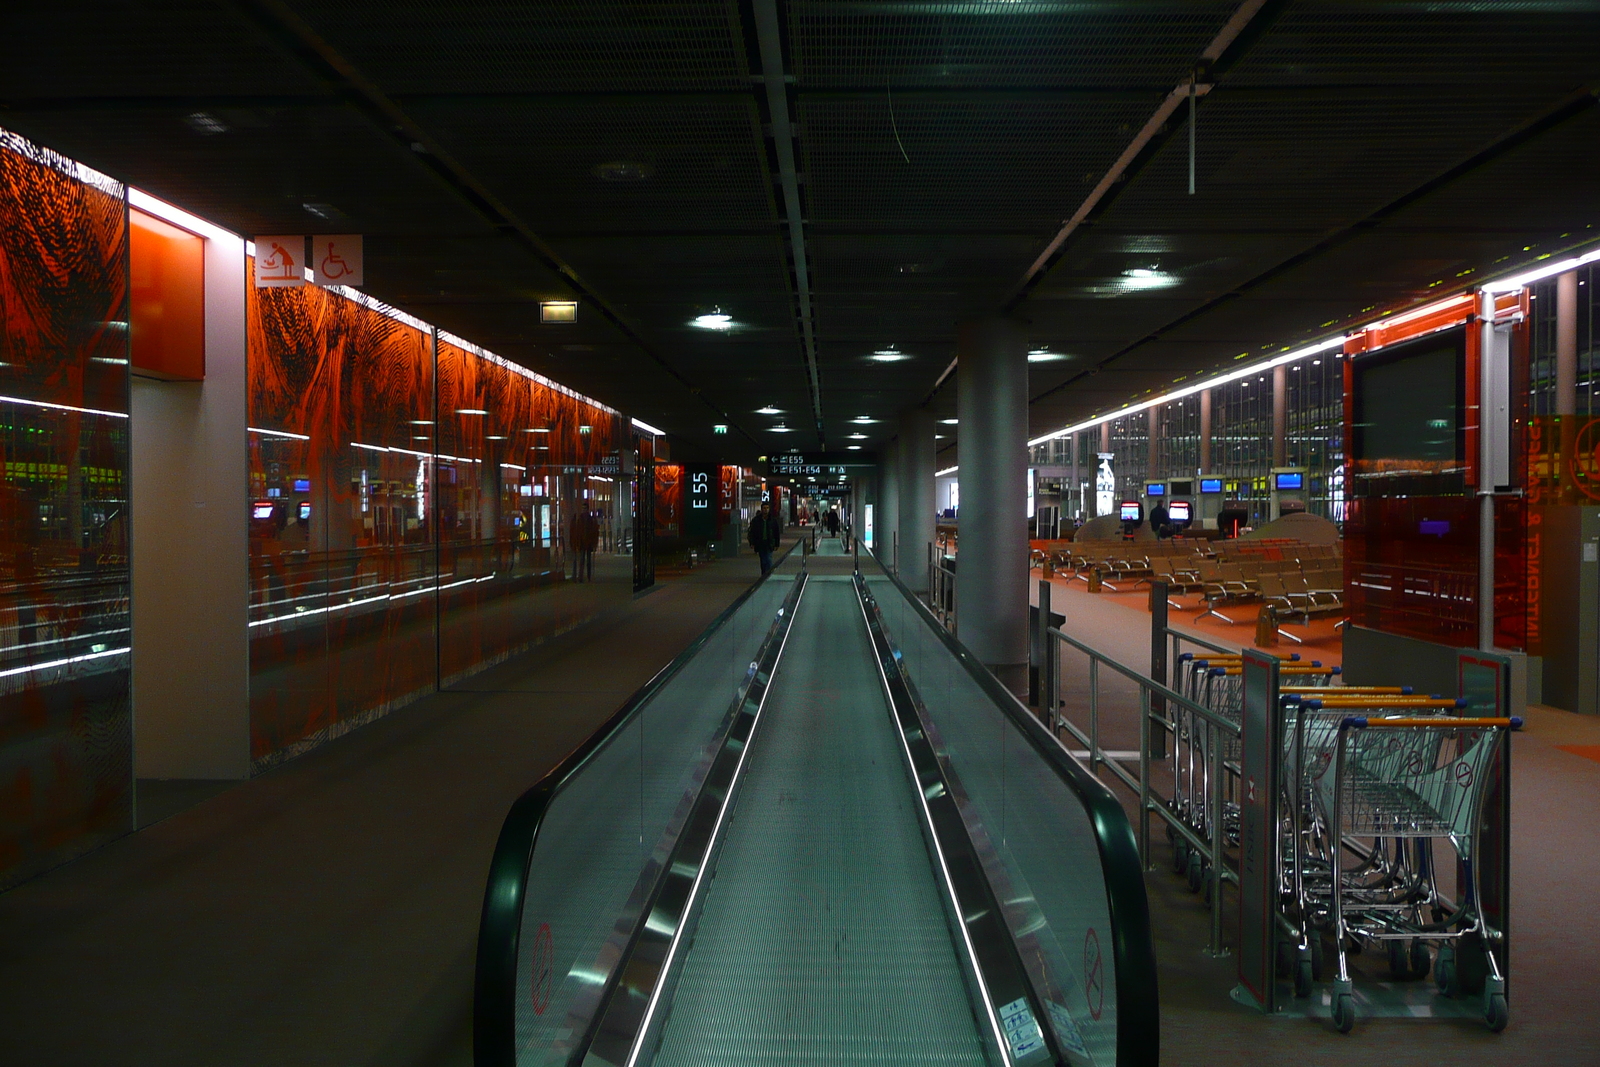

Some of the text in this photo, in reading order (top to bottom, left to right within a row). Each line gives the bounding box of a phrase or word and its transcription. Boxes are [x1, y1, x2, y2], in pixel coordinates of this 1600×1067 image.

[789, 456, 804, 464] E55
[693, 472, 708, 509] E 55
